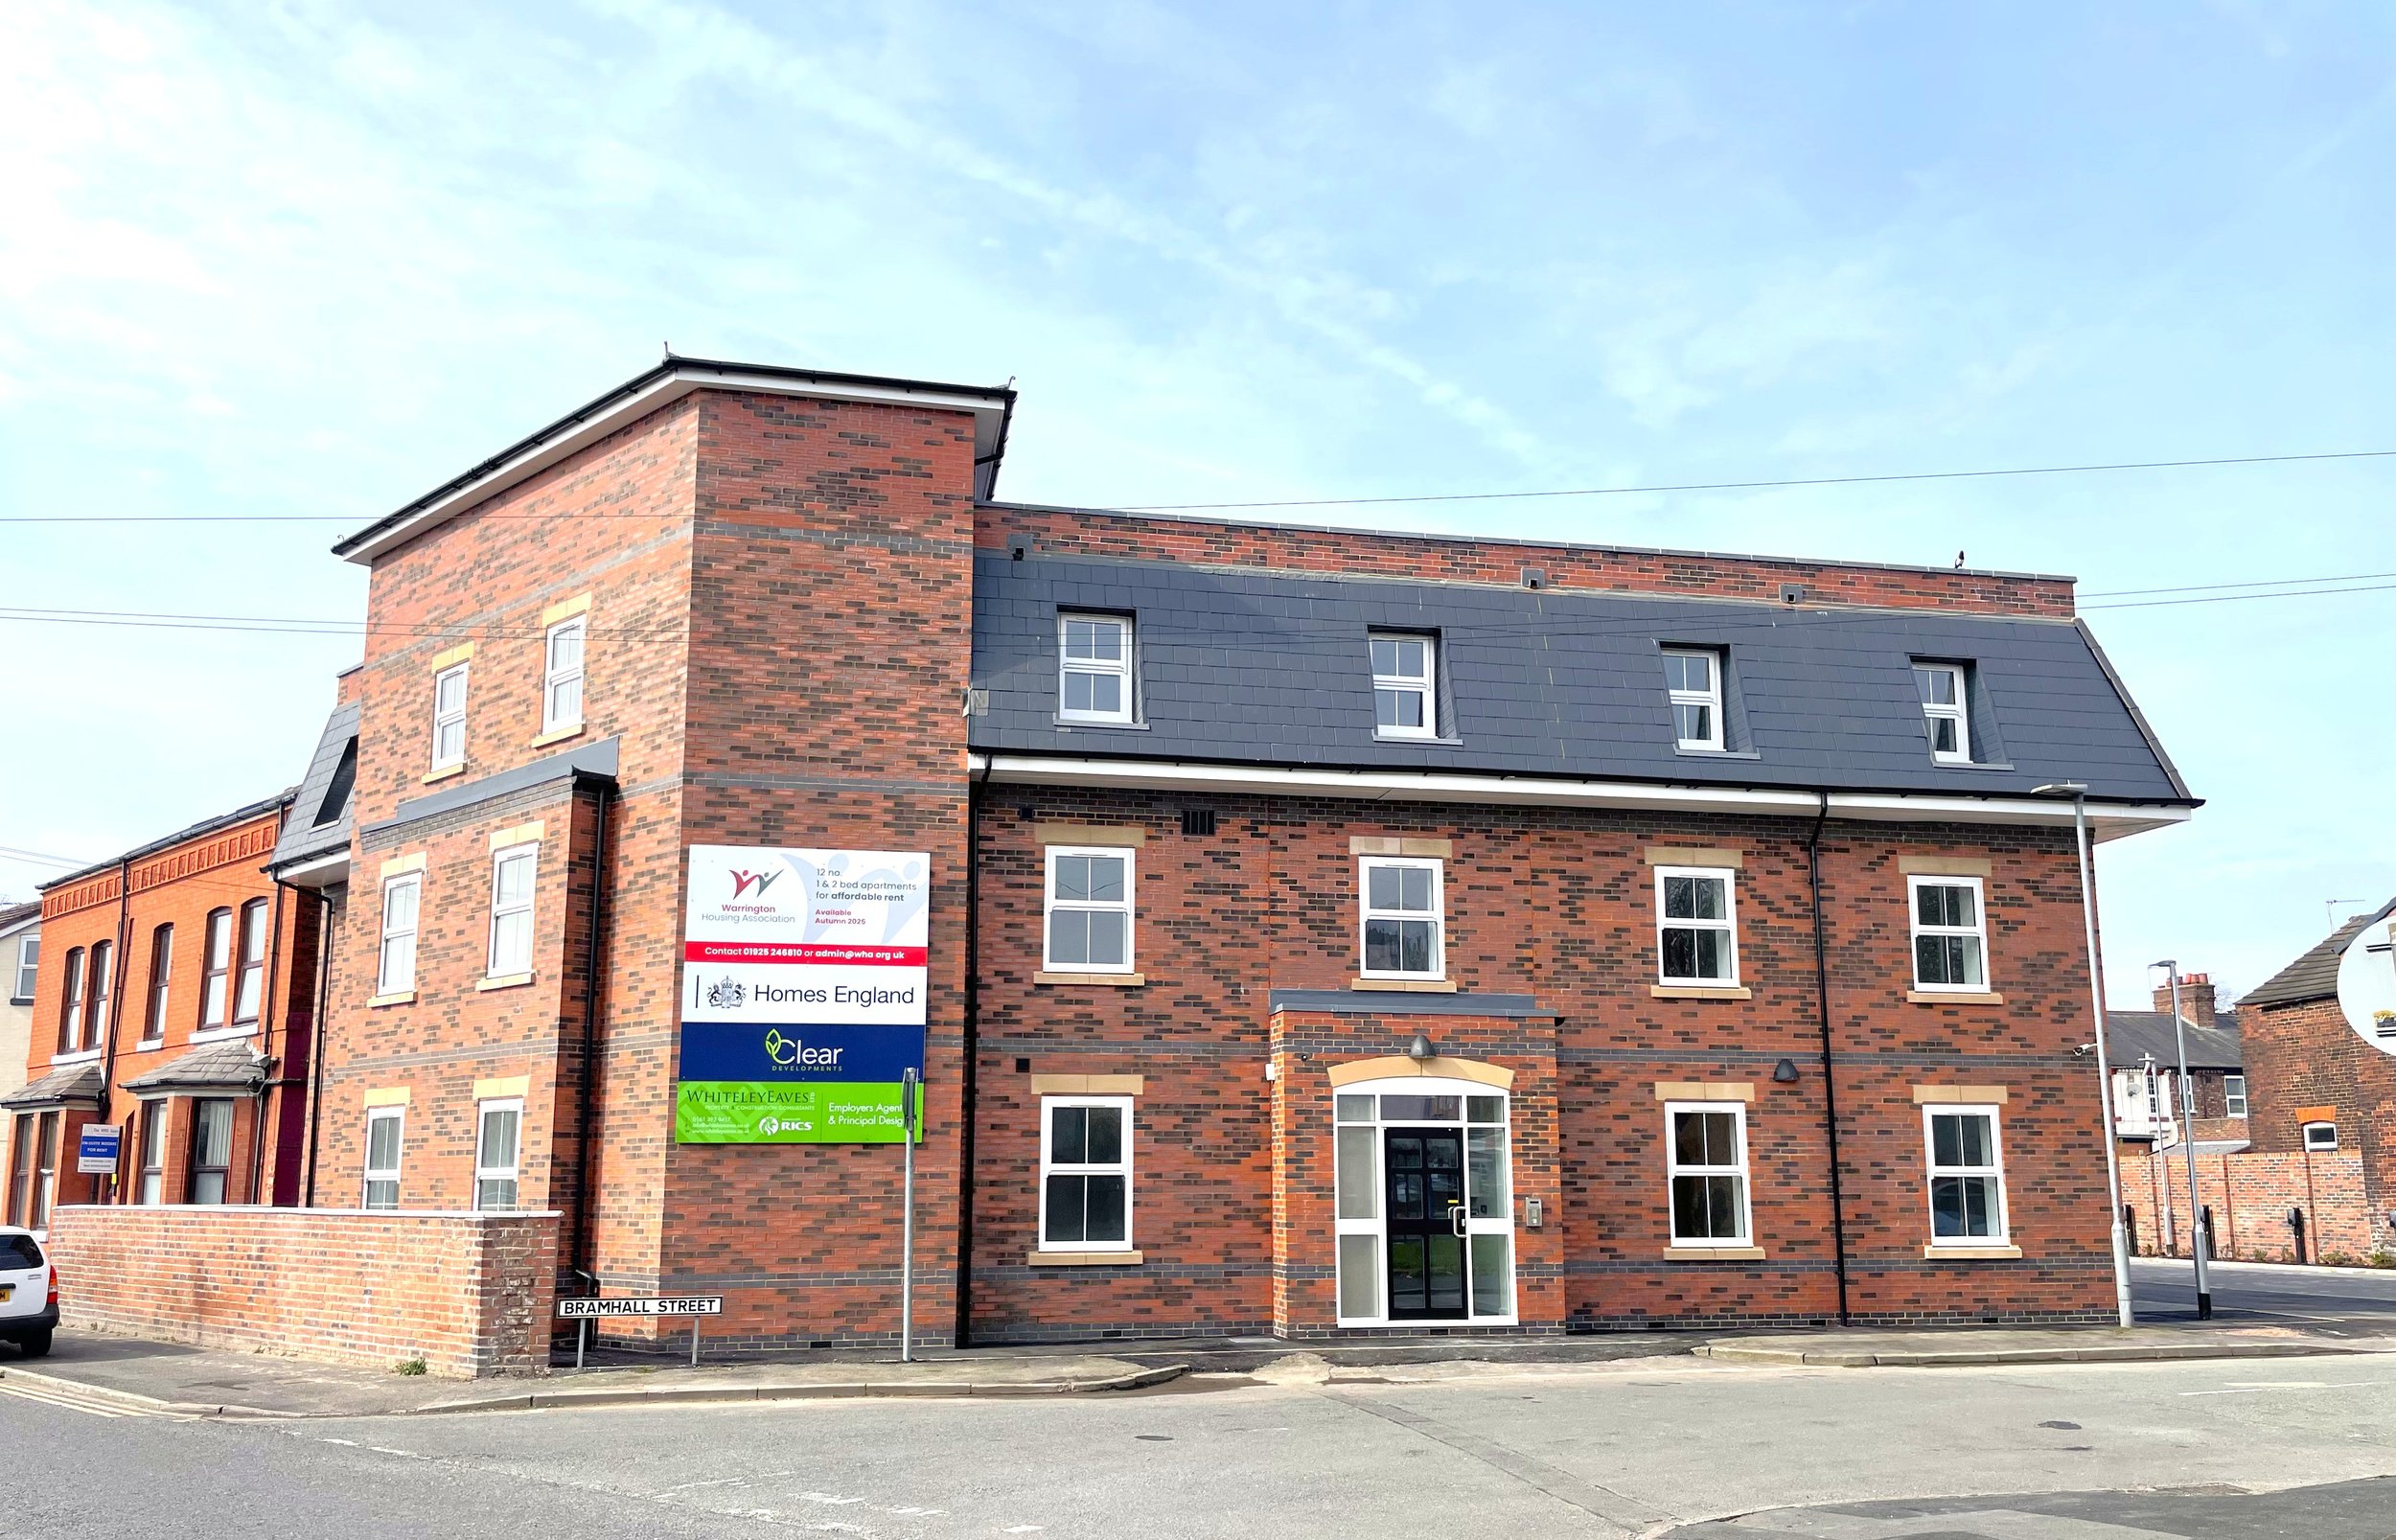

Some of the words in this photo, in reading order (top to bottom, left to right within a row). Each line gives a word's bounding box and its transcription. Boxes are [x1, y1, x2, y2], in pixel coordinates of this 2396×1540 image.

[821, 880, 829, 888] &
[861, 882, 917, 891] apartments
[831, 892, 883, 901] affordable
[722, 904, 776, 914] Warrington
[702, 913, 740, 924] Housing
[742, 914, 795, 923] Association
[704, 947, 742, 955] Contact
[743, 948, 770, 956] 01925
[771, 948, 802, 956] 246810
[816, 949, 906, 961] admin@whaorguk
[754, 984, 827, 1002] Homes
[835, 985, 914, 1008] England
[768, 1033, 843, 1065] Clear
[828, 1102, 874, 1114] Employers
[781, 1121, 813, 1131] RICS
[828, 1115, 836, 1125] &
[838, 1115, 877, 1127] Principal
[879, 1116, 904, 1127] Desig
[564, 1300, 651, 1314] BRAMHALL
[657, 1299, 716, 1313] STREET
